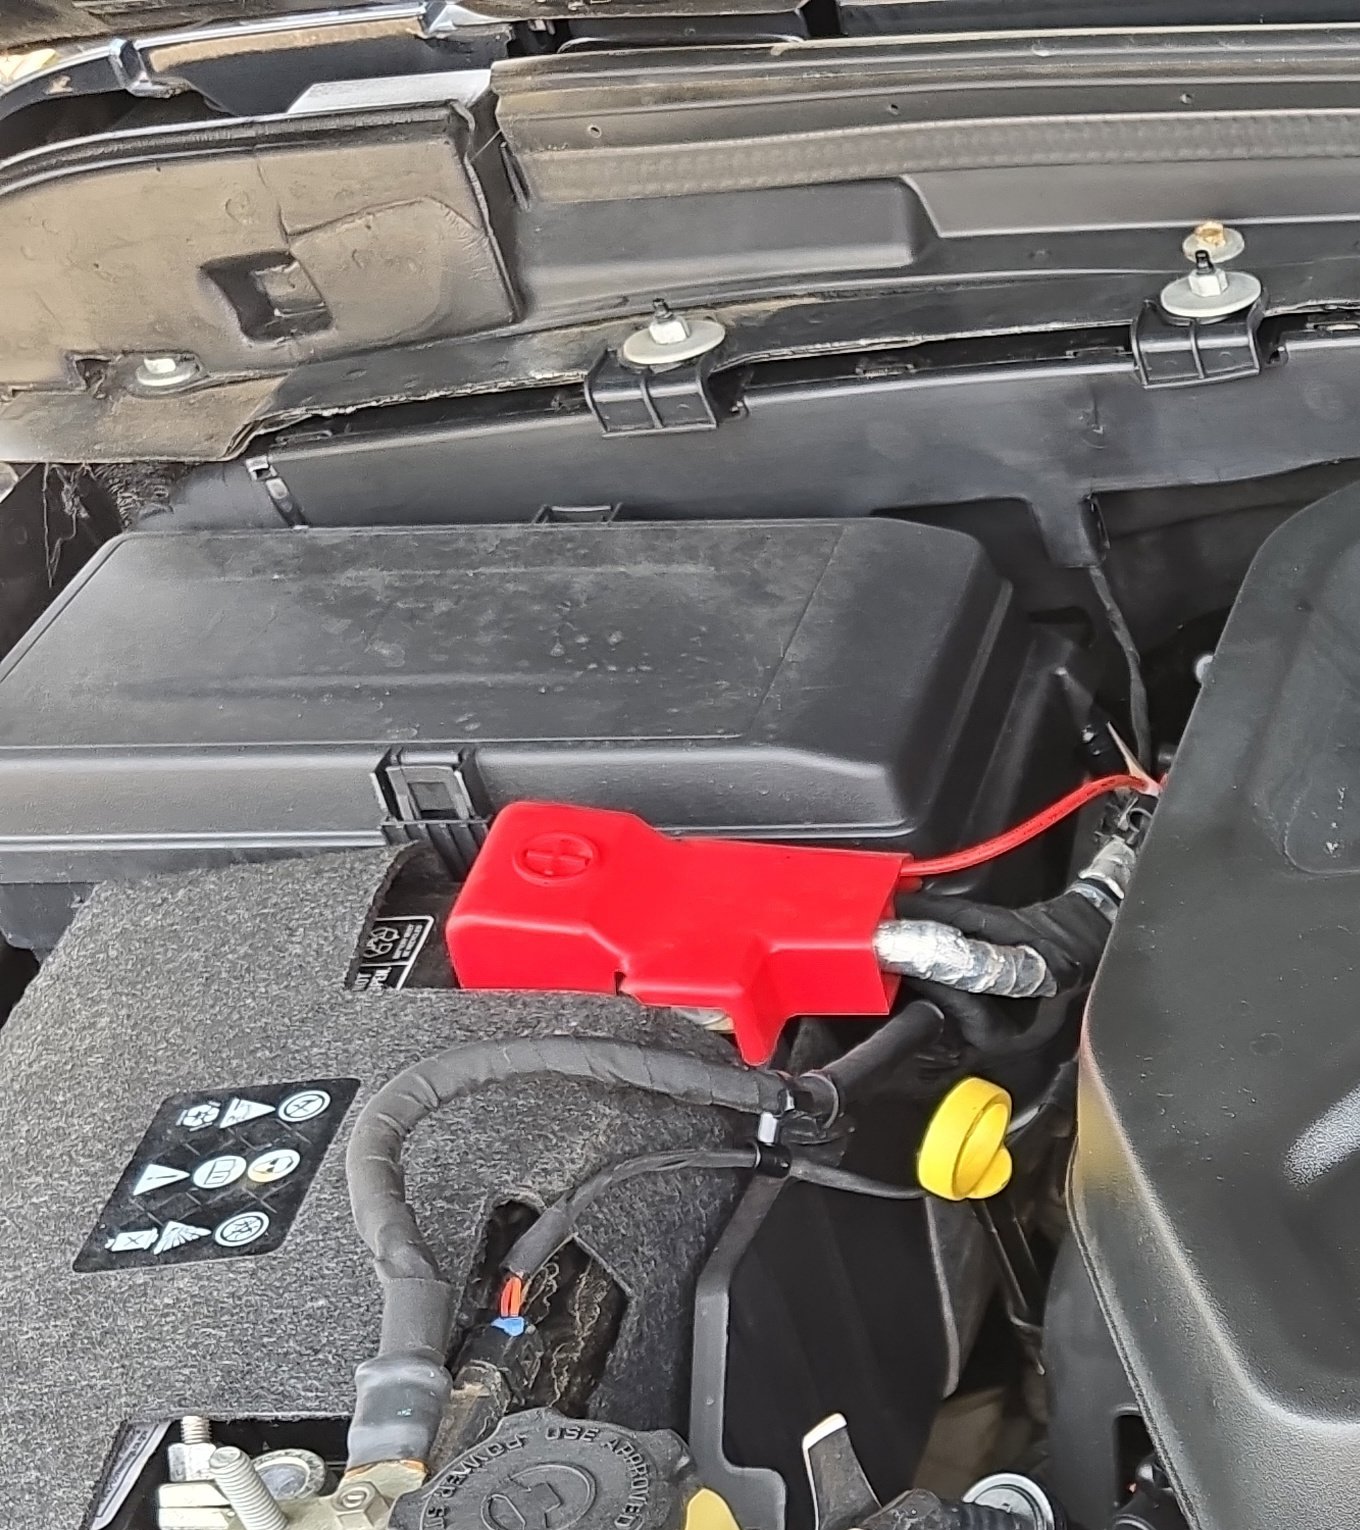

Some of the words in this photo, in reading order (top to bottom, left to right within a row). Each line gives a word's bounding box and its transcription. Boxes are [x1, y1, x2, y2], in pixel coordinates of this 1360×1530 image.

[434, 1434, 527, 1499] POWER
[545, 1426, 600, 1442] USE
[602, 1437, 651, 1529] APPROVED
